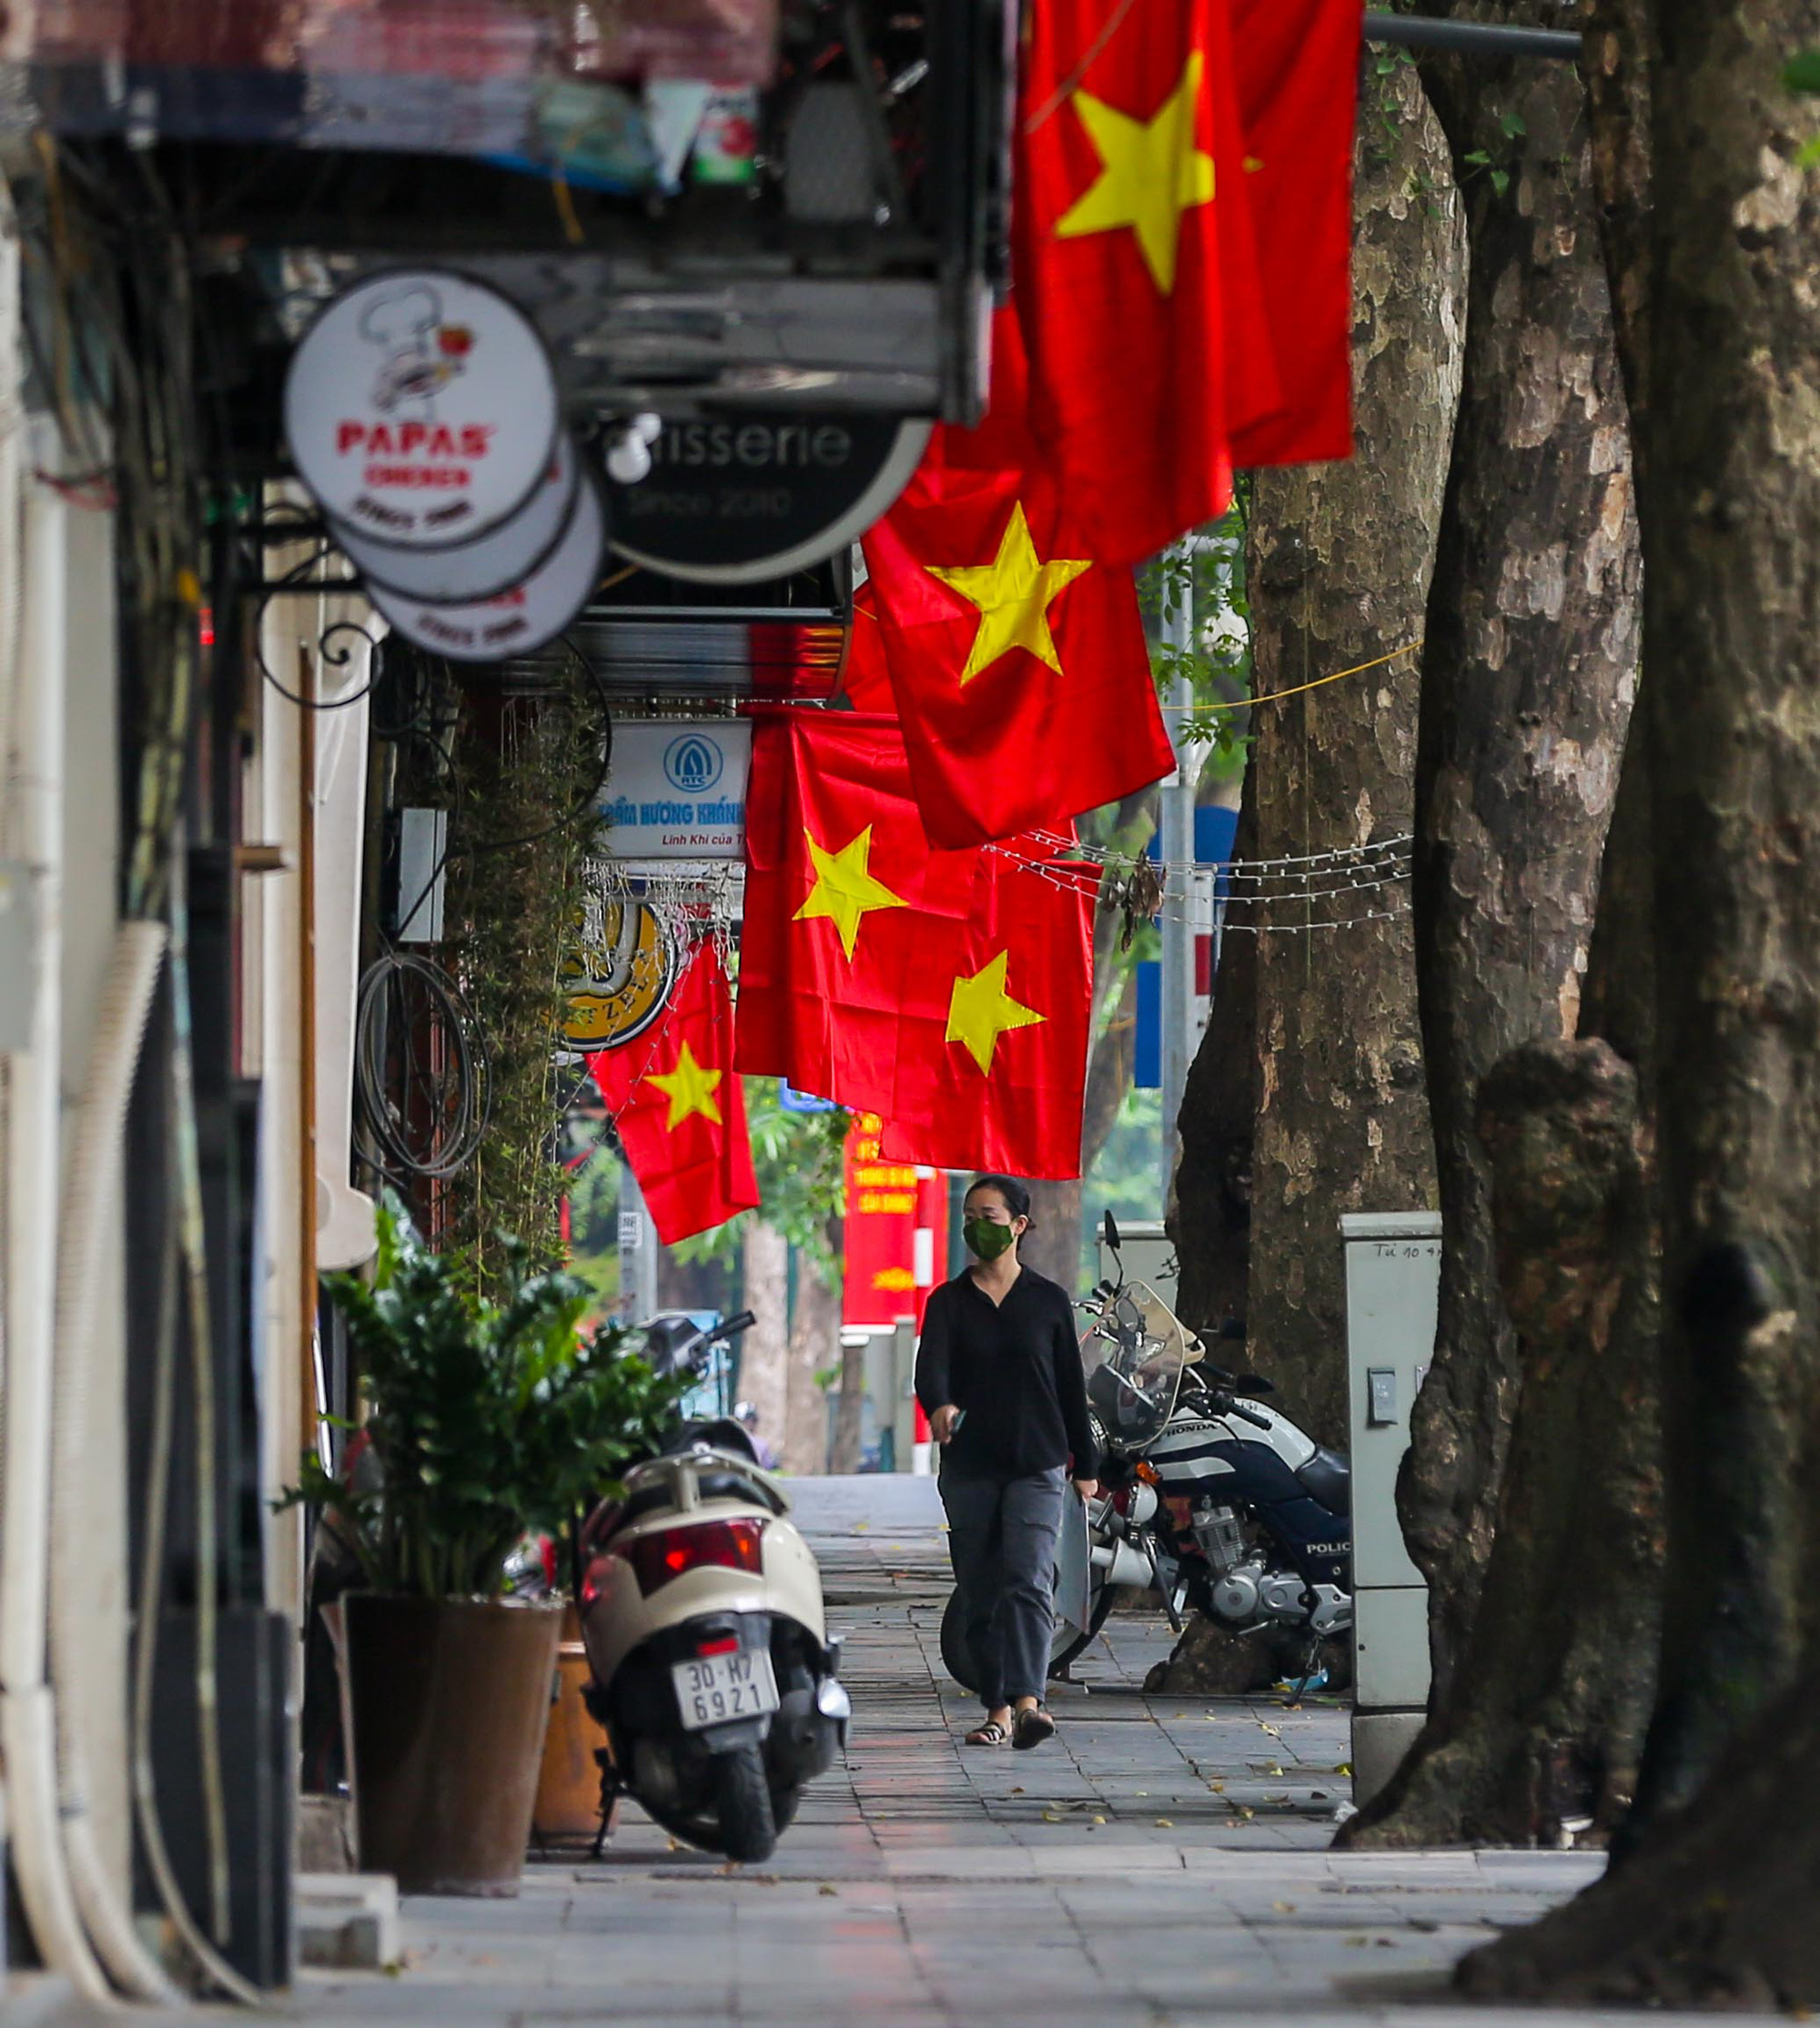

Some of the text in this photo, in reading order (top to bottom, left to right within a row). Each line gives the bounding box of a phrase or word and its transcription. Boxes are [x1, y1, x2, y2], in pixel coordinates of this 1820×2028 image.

[662, 834, 687, 845] Linh
[1166, 1423, 1218, 1437] HONDA
[1306, 1541, 1351, 1554] POLIC
[694, 1683, 761, 1721] 6921
